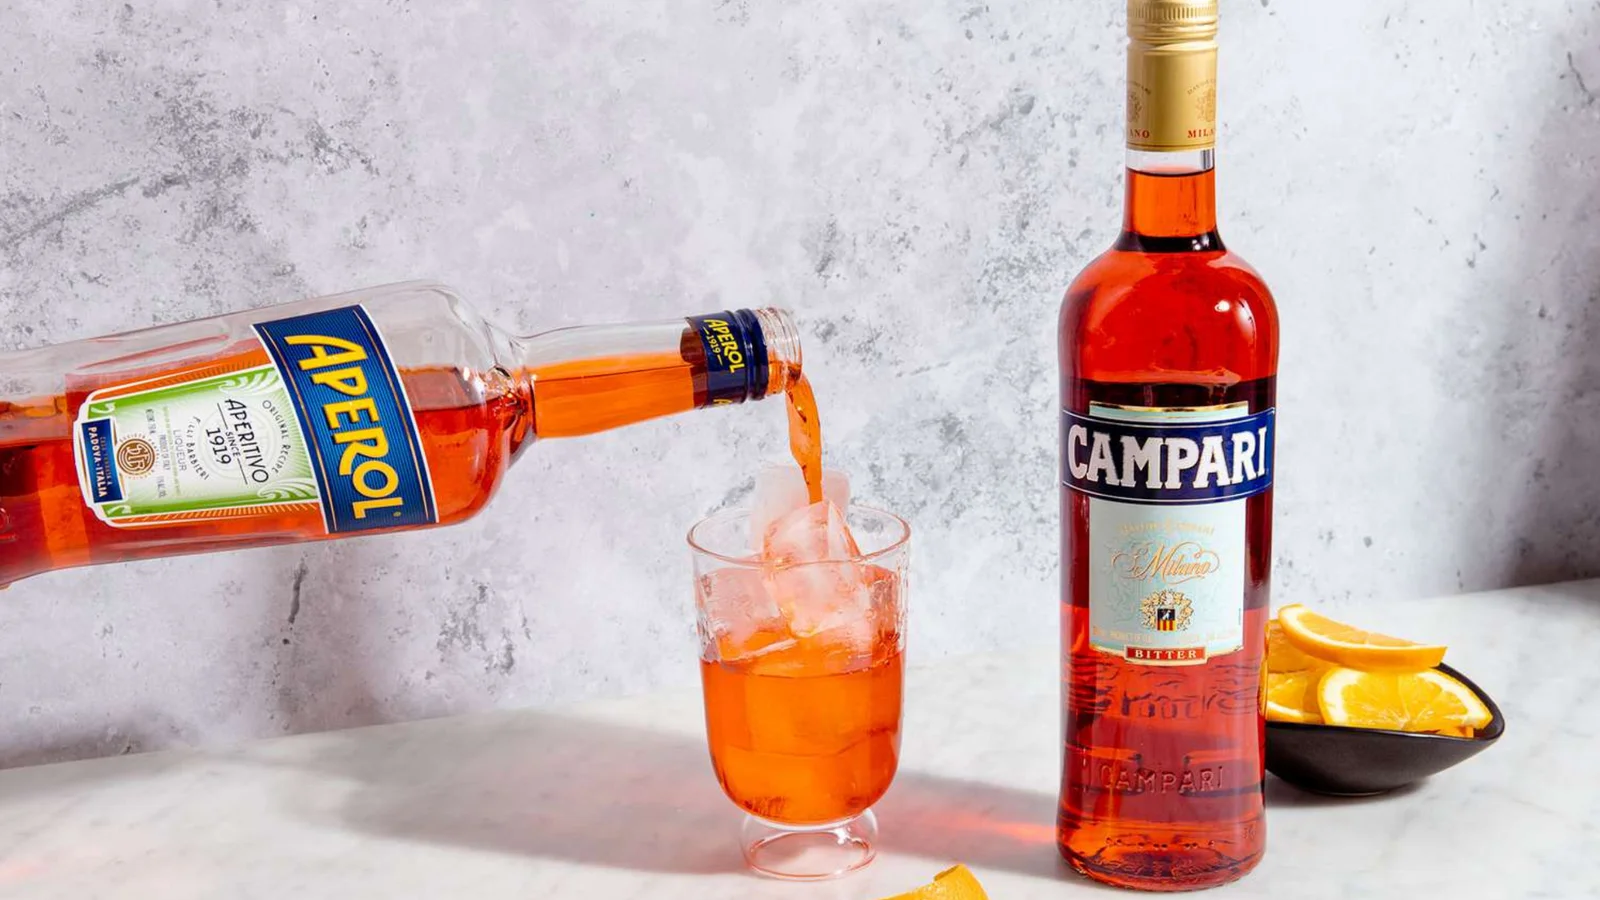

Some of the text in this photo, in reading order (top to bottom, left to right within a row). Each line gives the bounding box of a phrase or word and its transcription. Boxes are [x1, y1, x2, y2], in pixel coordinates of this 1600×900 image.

[704, 319, 745, 373] APEROL
[706, 335, 721, 354] 1919
[205, 427, 232, 465] 1919
[224, 399, 269, 483] APERITIVO
[225, 431, 241, 457] SINCE
[262, 400, 291, 474] ORIGINAL RECIPE
[284, 334, 403, 519] APEROL
[173, 429, 187, 472] LIQUEUR
[186, 442, 210, 481] BARBIERI
[1067, 424, 1268, 490] CAMPARI
[1126, 542, 1219, 584] Milano
[1135, 649, 1197, 659] BITTER
[1100, 764, 1224, 794] CAMPARI
